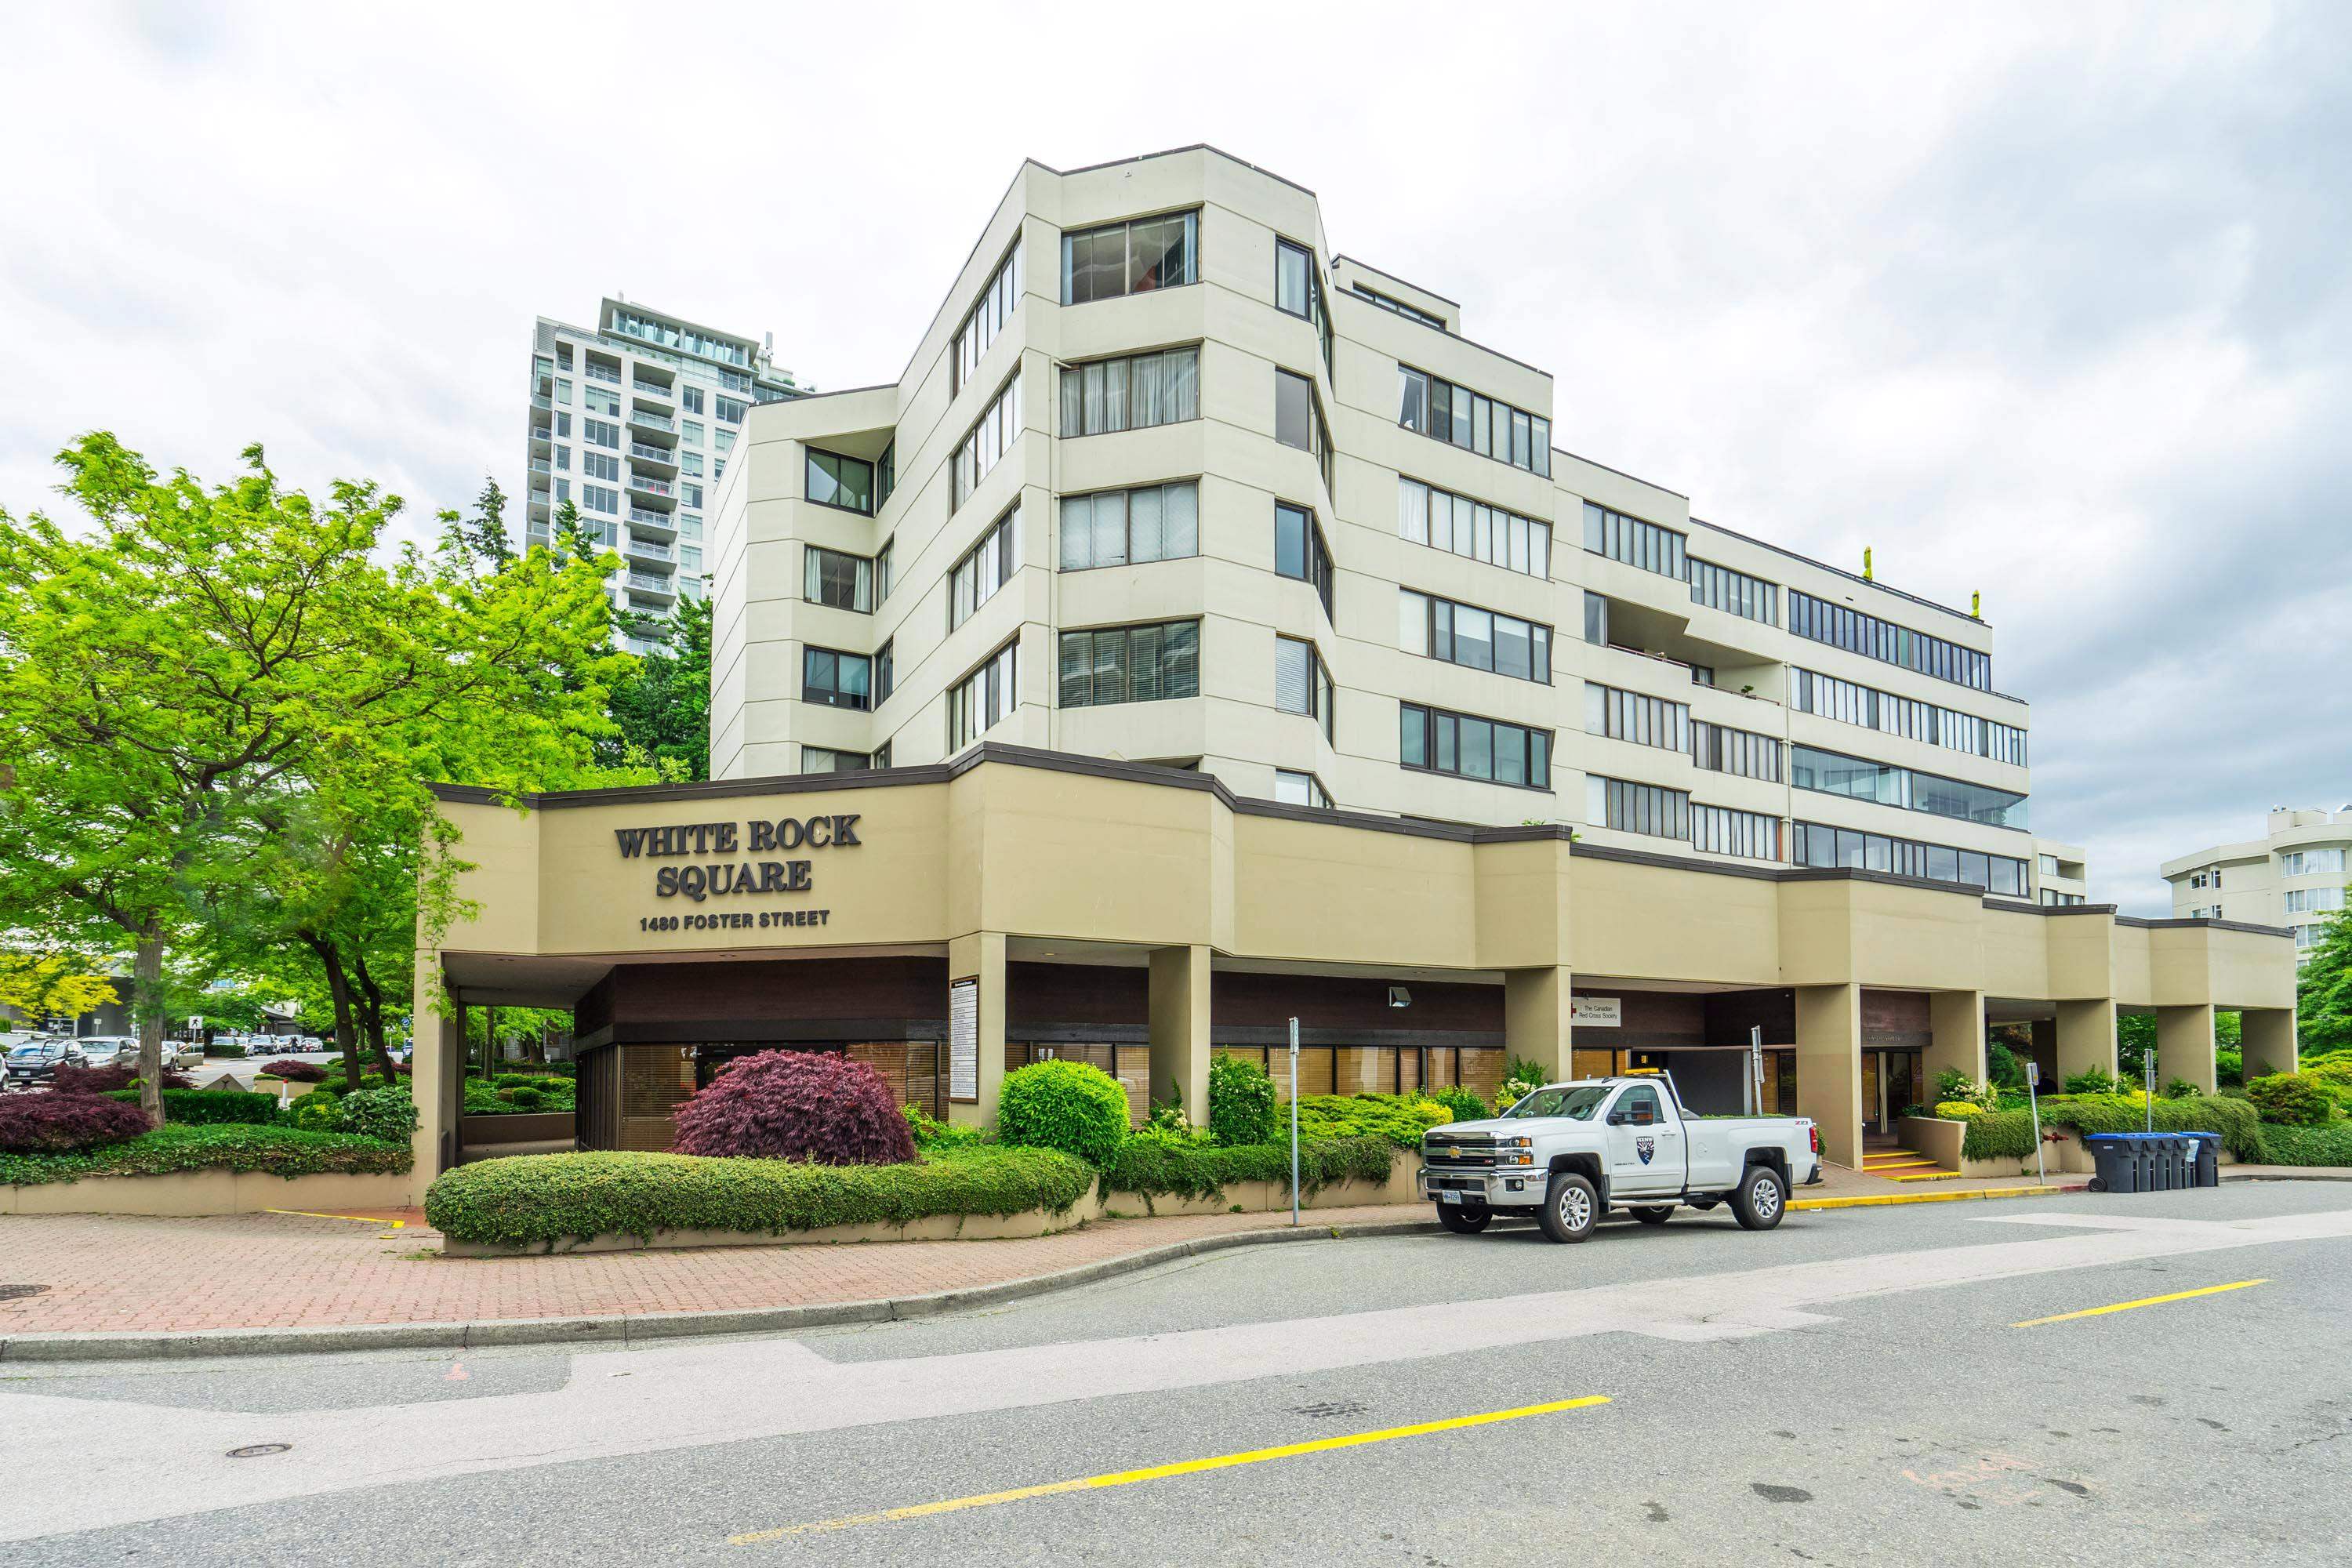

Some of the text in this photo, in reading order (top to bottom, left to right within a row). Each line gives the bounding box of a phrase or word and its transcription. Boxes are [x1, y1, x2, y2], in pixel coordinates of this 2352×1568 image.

[614, 814, 862, 858] WHITE ROCK
[656, 860, 811, 902] SQUARE
[640, 909, 830, 931] 1480 FOSTER STREET
